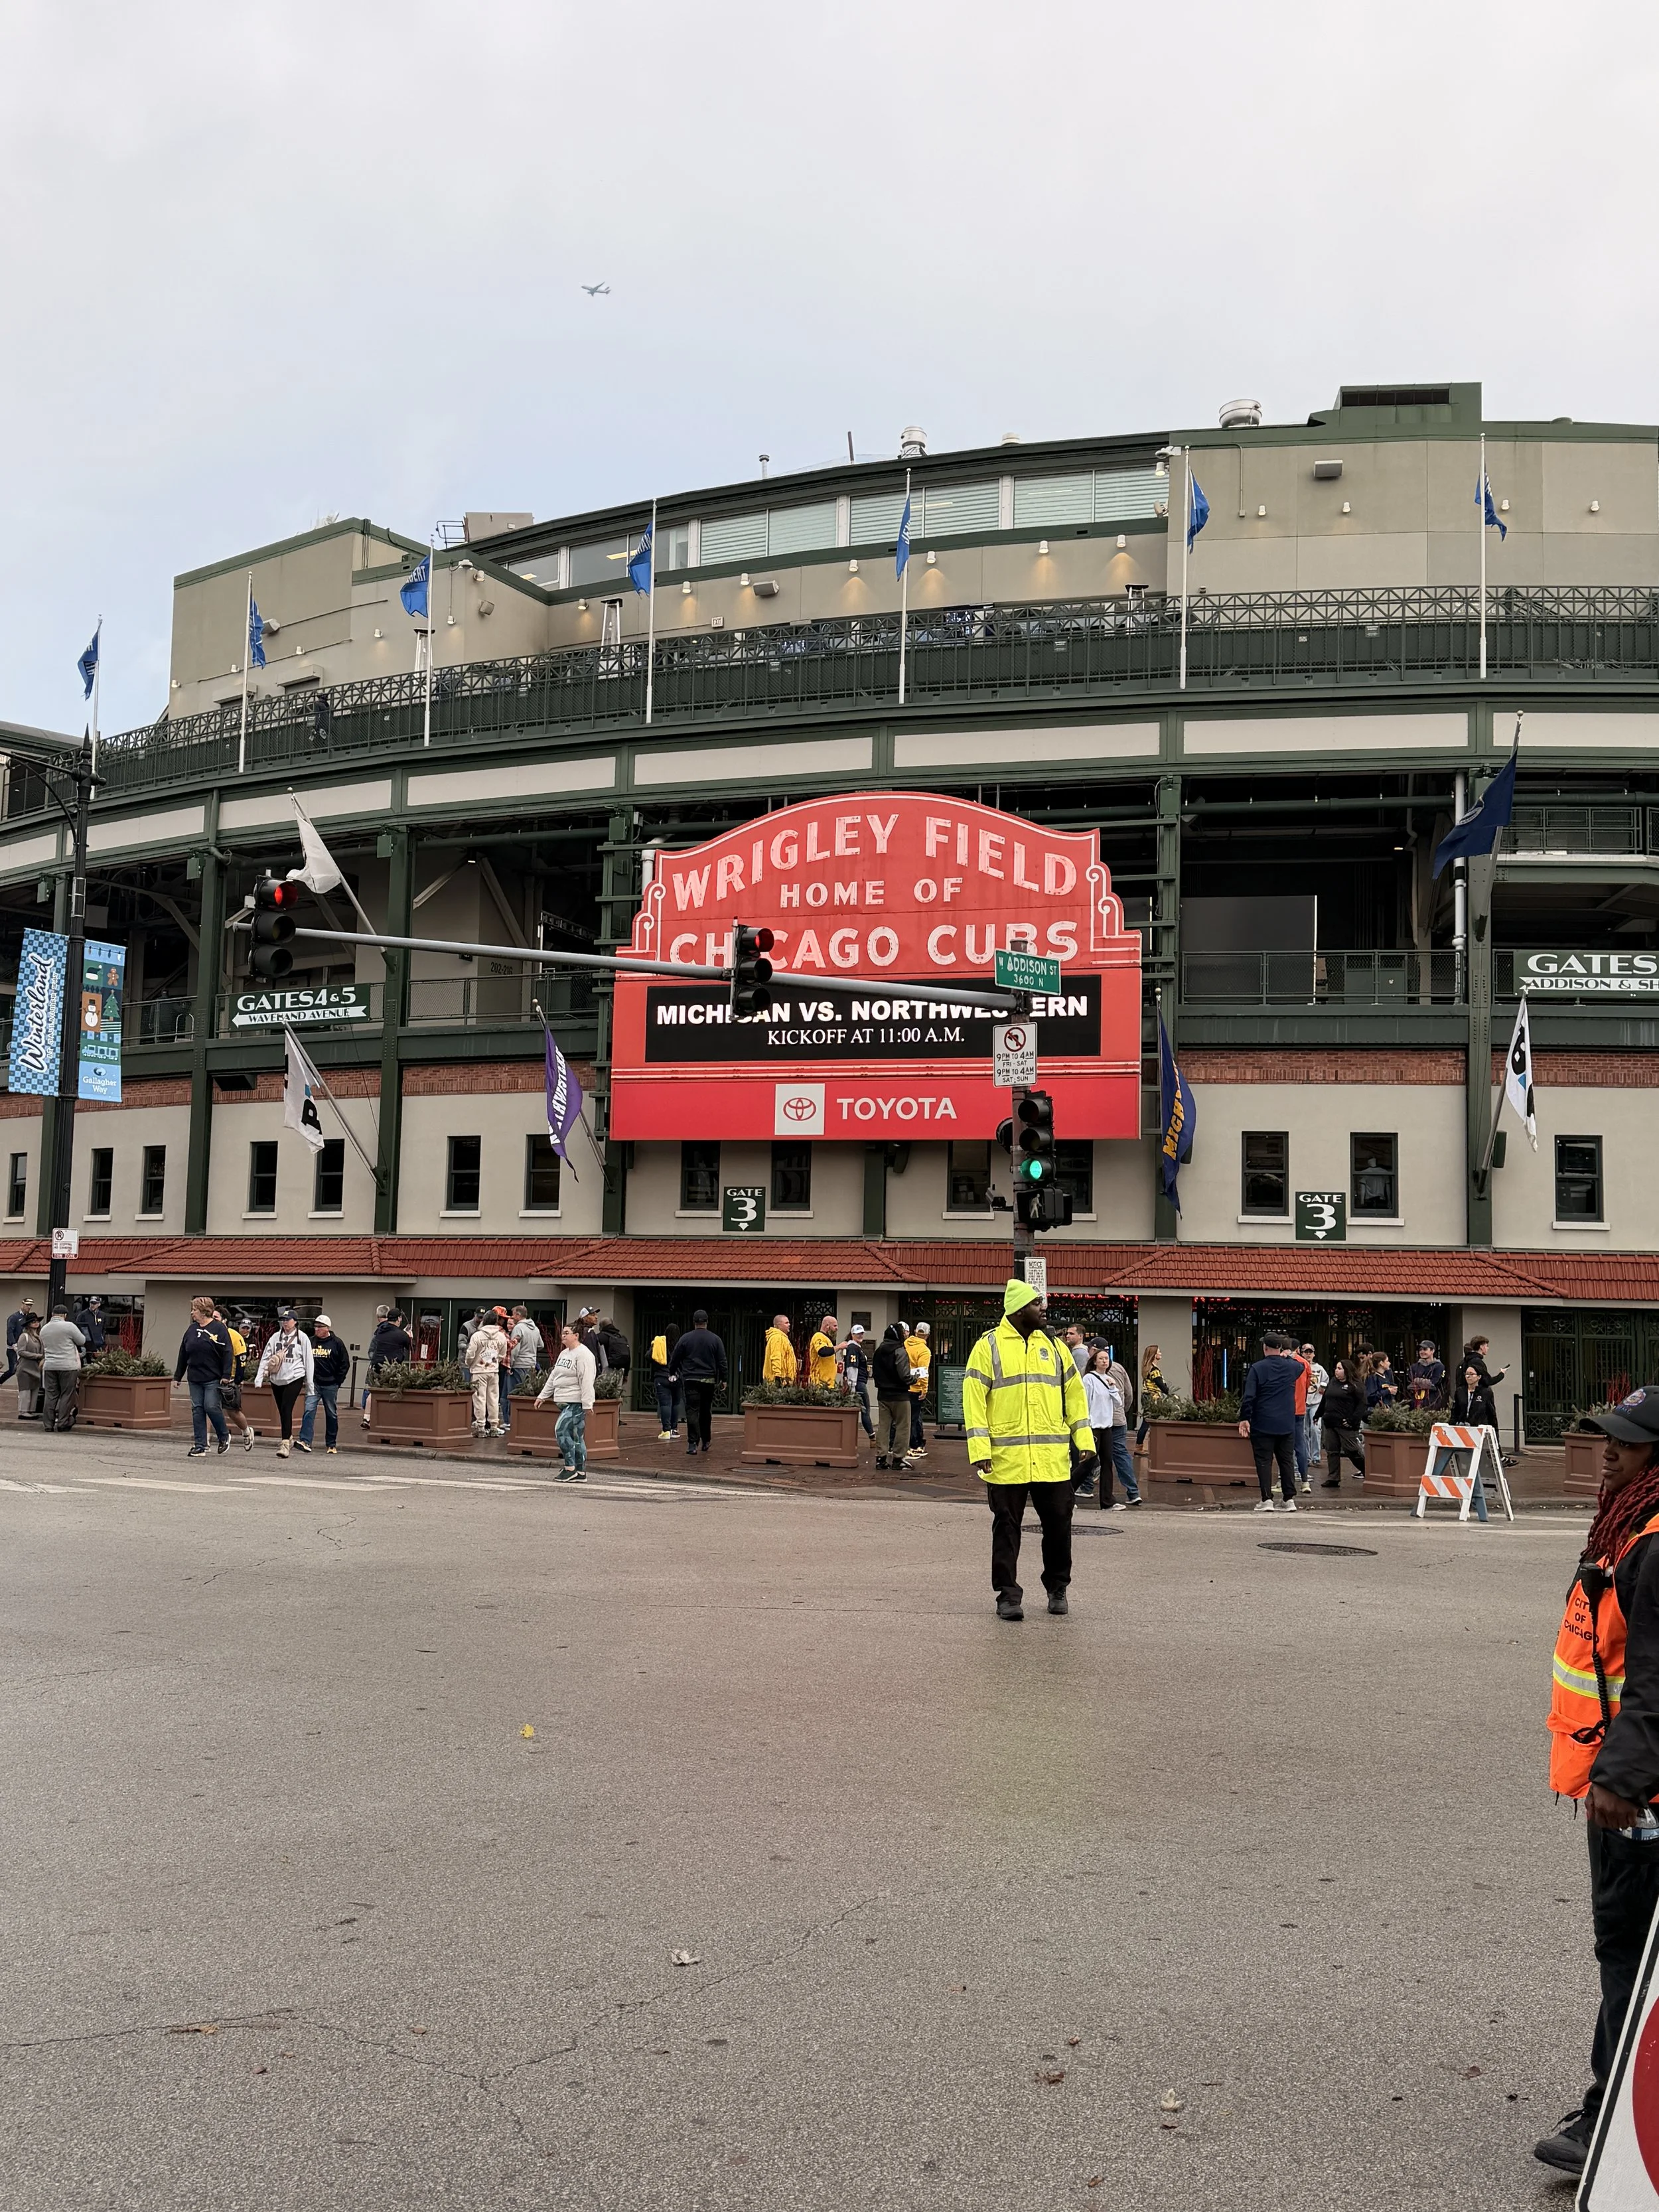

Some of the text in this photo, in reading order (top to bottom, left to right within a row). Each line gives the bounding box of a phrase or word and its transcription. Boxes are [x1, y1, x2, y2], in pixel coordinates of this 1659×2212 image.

[672, 814, 1077, 912] WRIGLEY FIELD
[780, 877, 964, 909] HOME OF
[670, 921, 1078, 970] CHCAGO CUBS
[1007, 956, 1047, 976] ADDISON
[1049, 965, 1057, 976] ST
[1528, 954, 1658, 974] GATES
[1013, 973, 1044, 988] 3600 N
[1528, 978, 1611, 989] ADDISON
[1618, 979, 1631, 990] &
[237, 986, 356, 1011] GATES 4 & 5
[19, 952, 54, 1072] Winterland
[309, 1007, 350, 1019] AVENUE
[798, 1001, 842, 1022] VS.
[767, 1026, 965, 1045] KICKOFF AT 11:00 A.M.
[996, 1053, 1010, 1062] 9PM
[1020, 1051, 1034, 1060] 4AM
[1020, 1067, 1034, 1075] 4AM
[82, 1076, 117, 1087] Gallagher
[92, 1084, 108, 1094] Way
[836, 1096, 958, 1120] TOYOTA
[1162, 1059, 1185, 1161] MICH
[1299, 1194, 1342, 1203] GATE
[731, 1197, 757, 1222] 3
[1305, 1203, 1336, 1230] 3
[1575, 1597, 1589, 1610] CIT
[1575, 1612, 1587, 1623] OF
